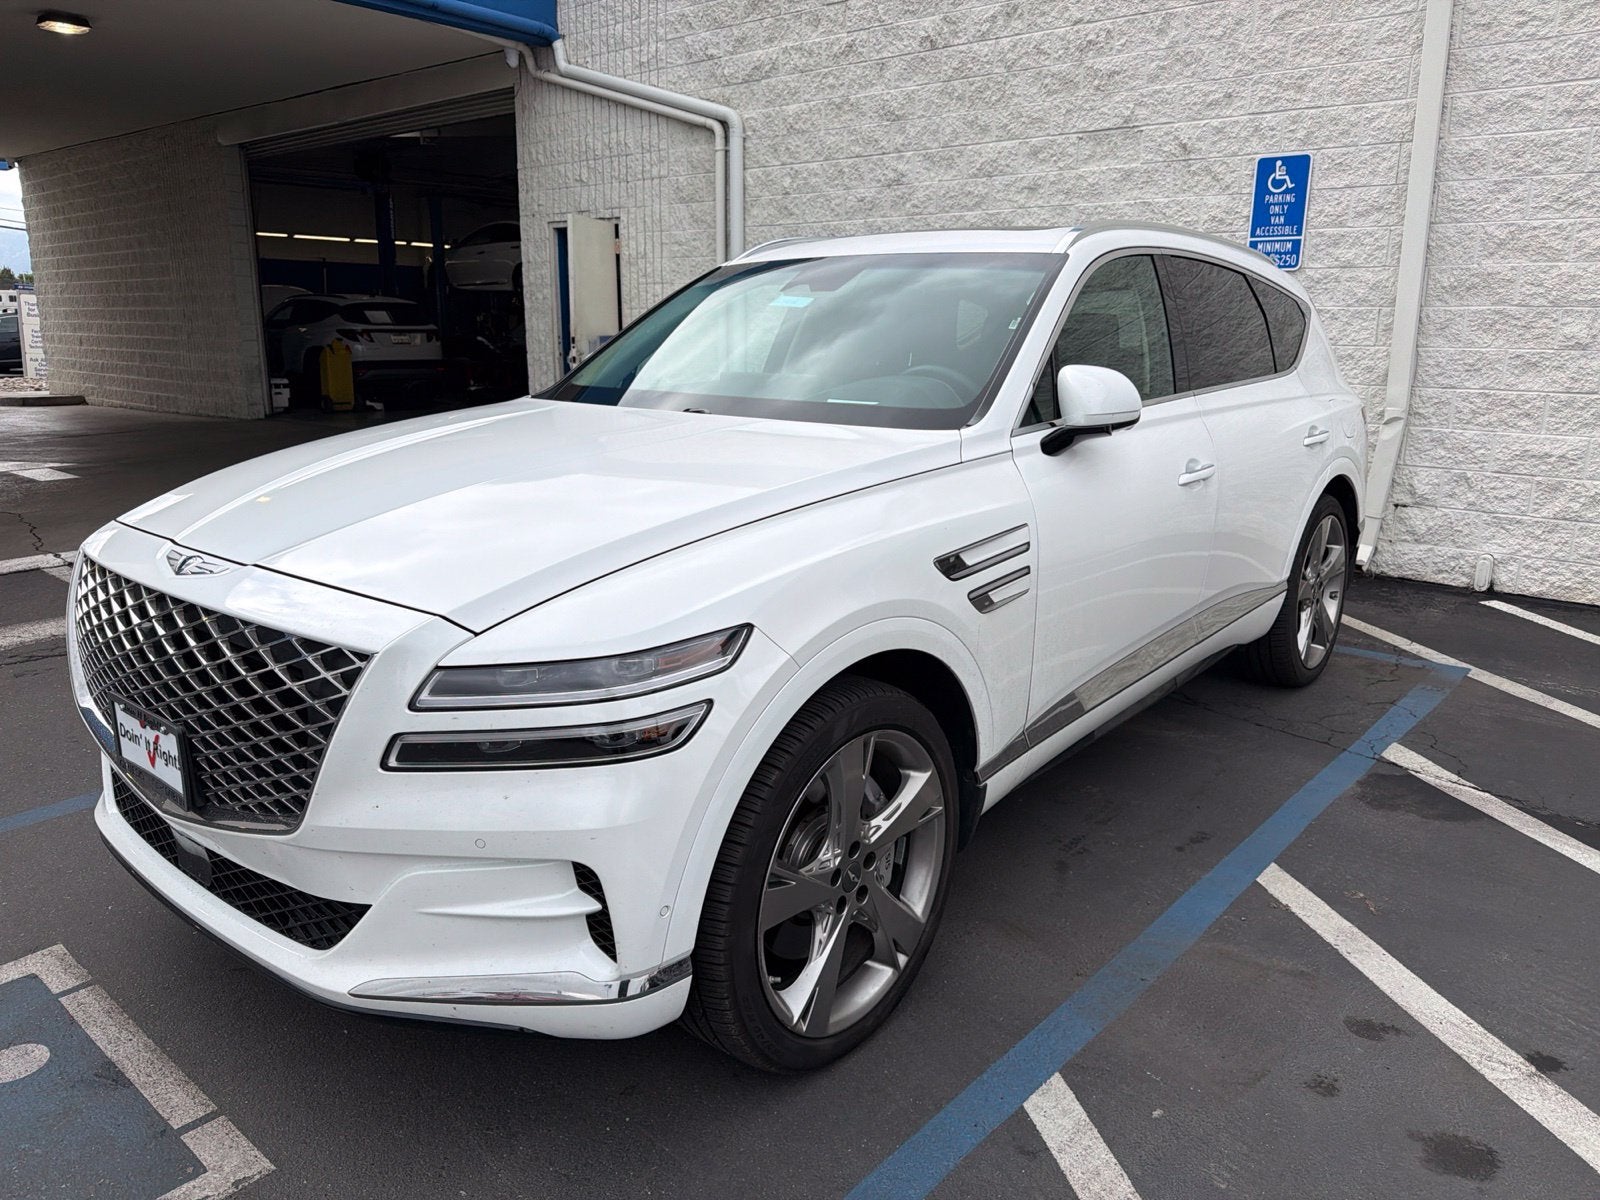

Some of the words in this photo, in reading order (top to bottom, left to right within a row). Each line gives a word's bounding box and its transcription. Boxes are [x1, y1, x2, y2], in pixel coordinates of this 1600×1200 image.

[1264, 193, 1296, 204] PARKING
[1269, 204, 1289, 215] ONLY
[1270, 215, 1285, 225] VAN
[1255, 225, 1298, 236] ACCESSIBLE
[1257, 241, 1292, 253] MINIMUM
[119, 722, 143, 747] Doin'
